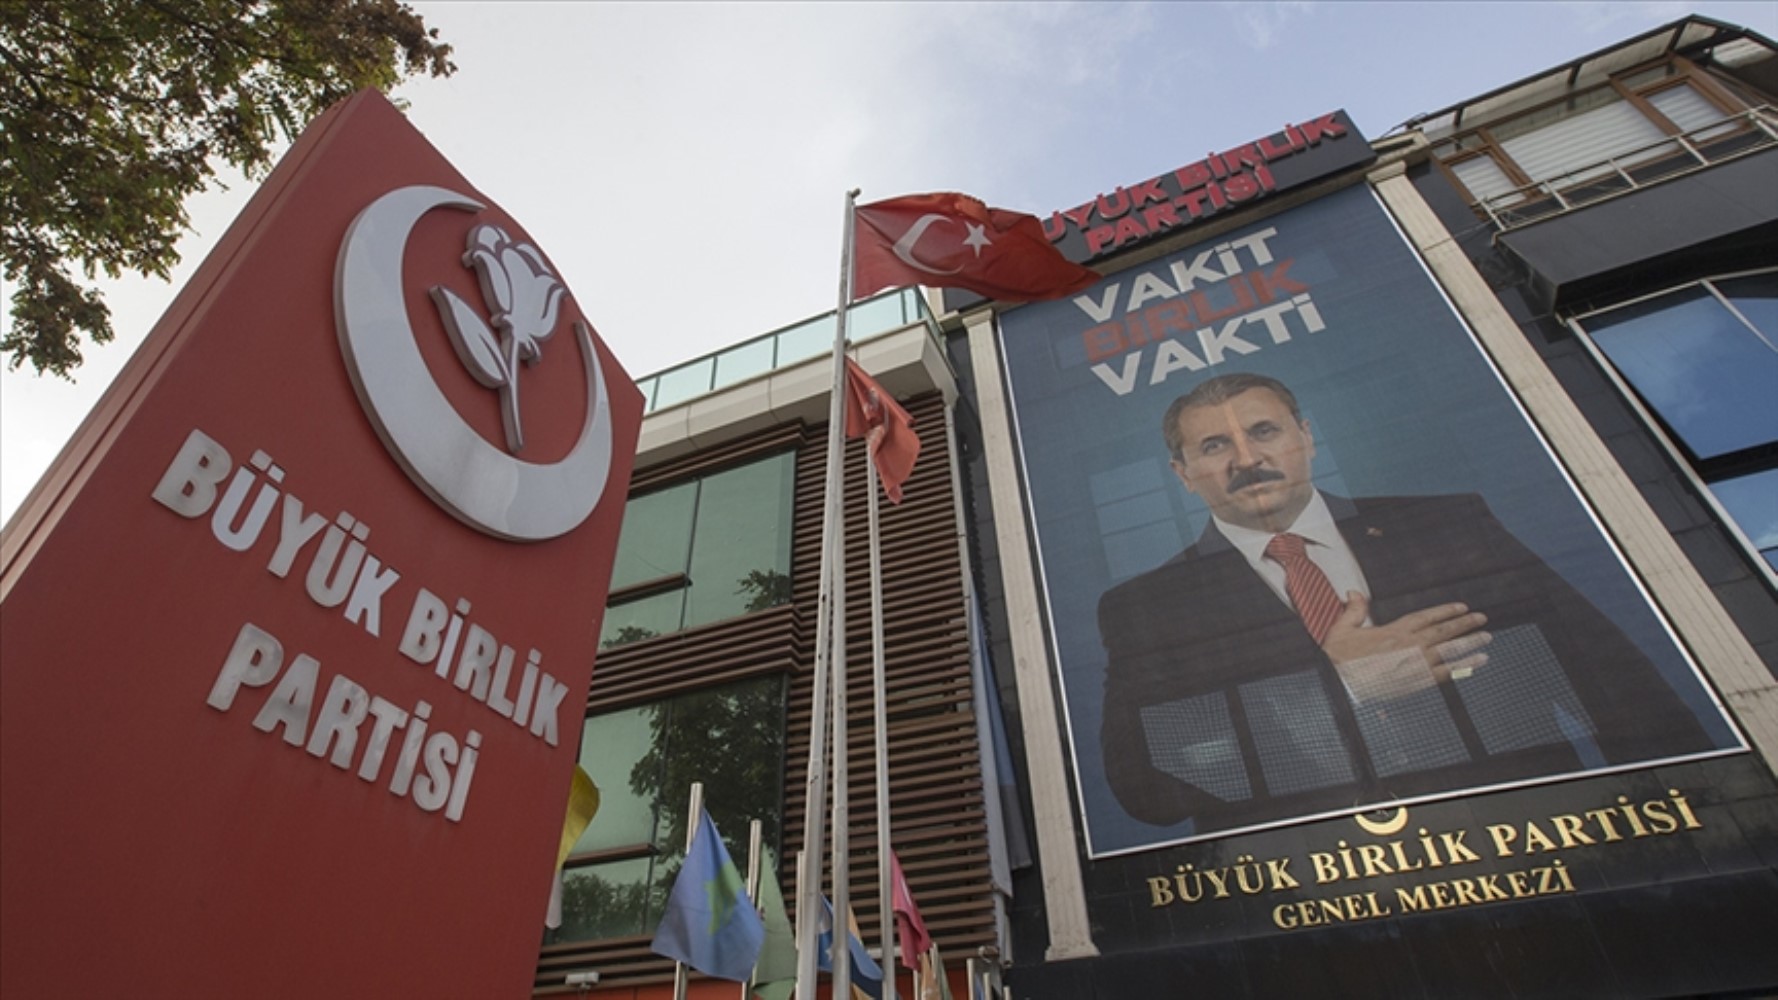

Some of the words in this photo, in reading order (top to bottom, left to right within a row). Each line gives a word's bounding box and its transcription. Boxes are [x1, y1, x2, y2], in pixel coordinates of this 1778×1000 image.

[1040, 176, 1169, 242] ÜYÜK
[1175, 112, 1348, 192] BİRLİK
[1085, 164, 1277, 255] PARTİSİ
[1073, 227, 1278, 323] VAKİT
[1081, 257, 1312, 364] BİRLİK
[1090, 293, 1326, 396] VAKTİ
[151, 428, 401, 638] BÜYÜK
[399, 587, 569, 747] BİRLİK
[206, 622, 483, 823] PARTİSİ
[1147, 855, 1300, 908] BÜYÜK
[1309, 827, 1481, 886] BİRLİK
[1486, 788, 1702, 858] PARTİSİ
[1272, 880, 1391, 930] GENEL
[1398, 858, 1577, 916] MERKEZİ
